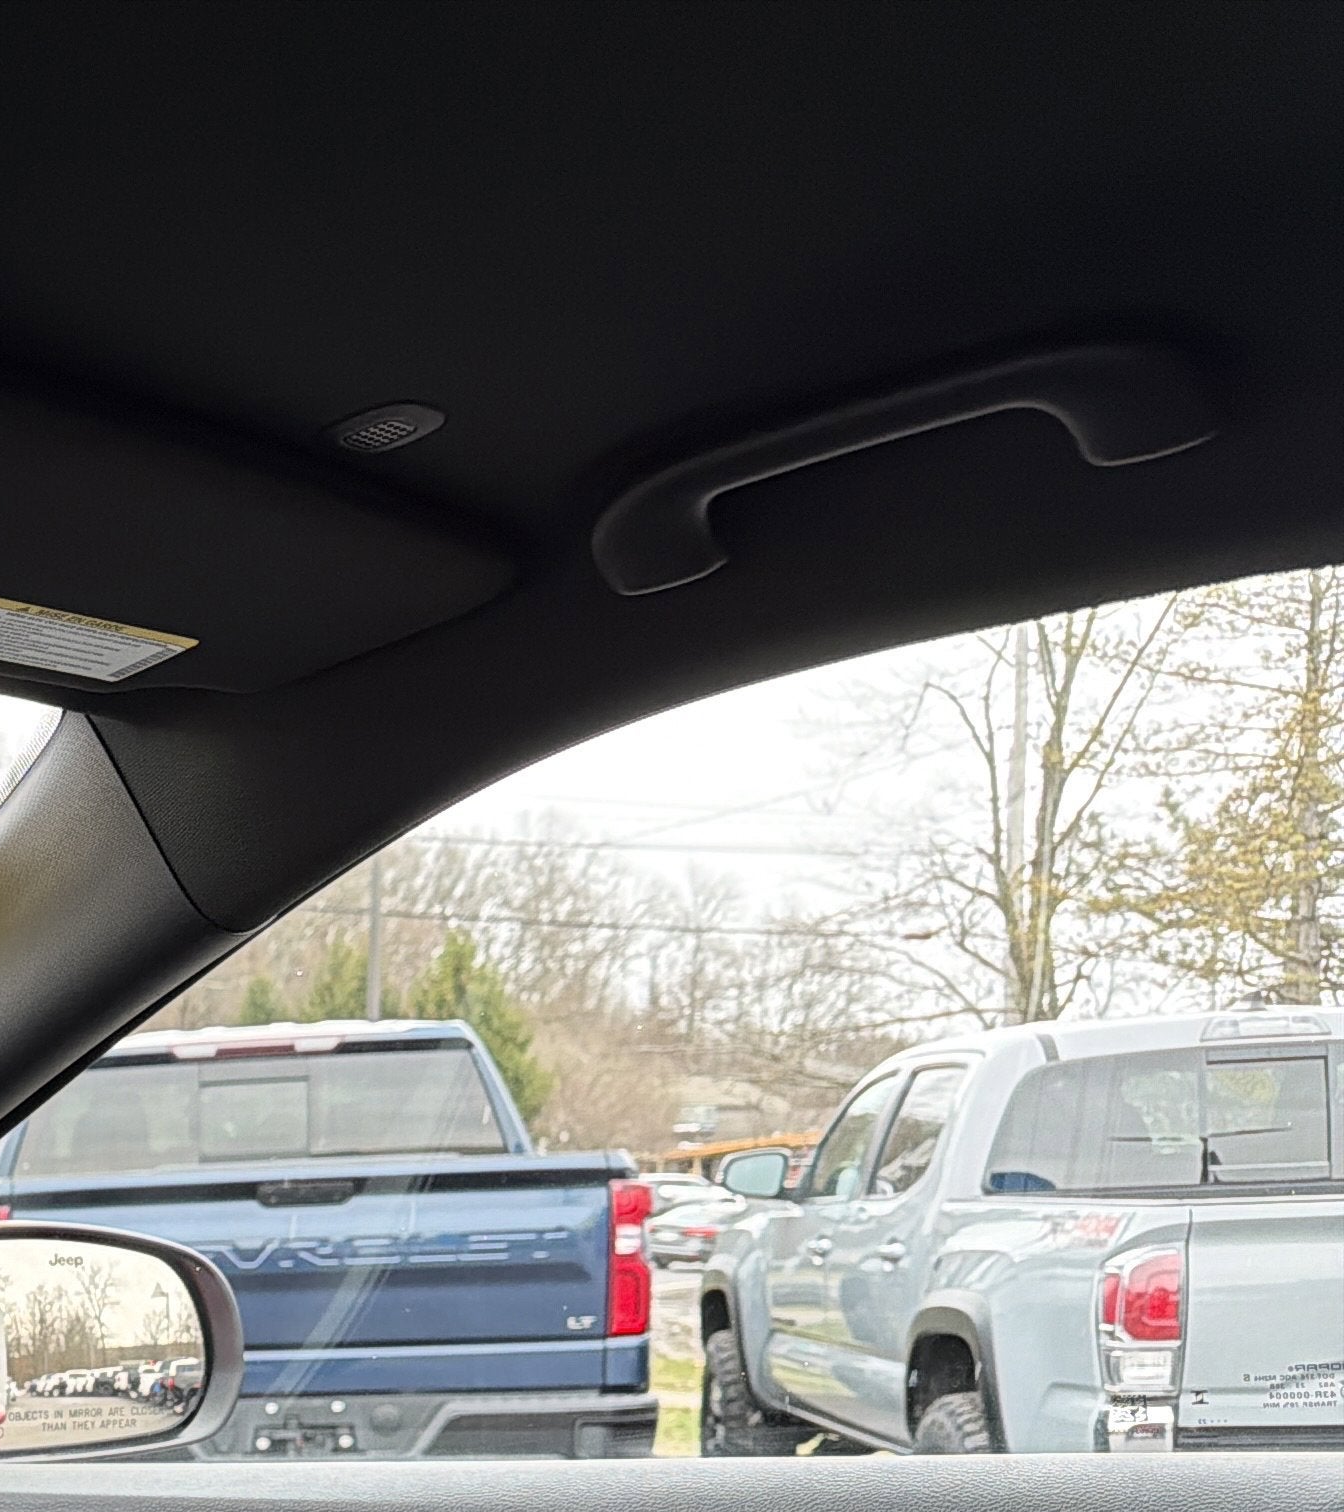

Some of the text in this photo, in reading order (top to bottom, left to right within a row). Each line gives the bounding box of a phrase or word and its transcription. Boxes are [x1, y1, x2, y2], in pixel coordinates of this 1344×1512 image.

[48, 1253, 84, 1267] Jeep
[8, 1409, 50, 1422] OBJECTS
[54, 1410, 63, 1419] IN
[68, 1407, 103, 1419] MIRROR
[108, 1406, 125, 1418] ARE
[41, 1418, 138, 1432] THAN THEY APPEAR
